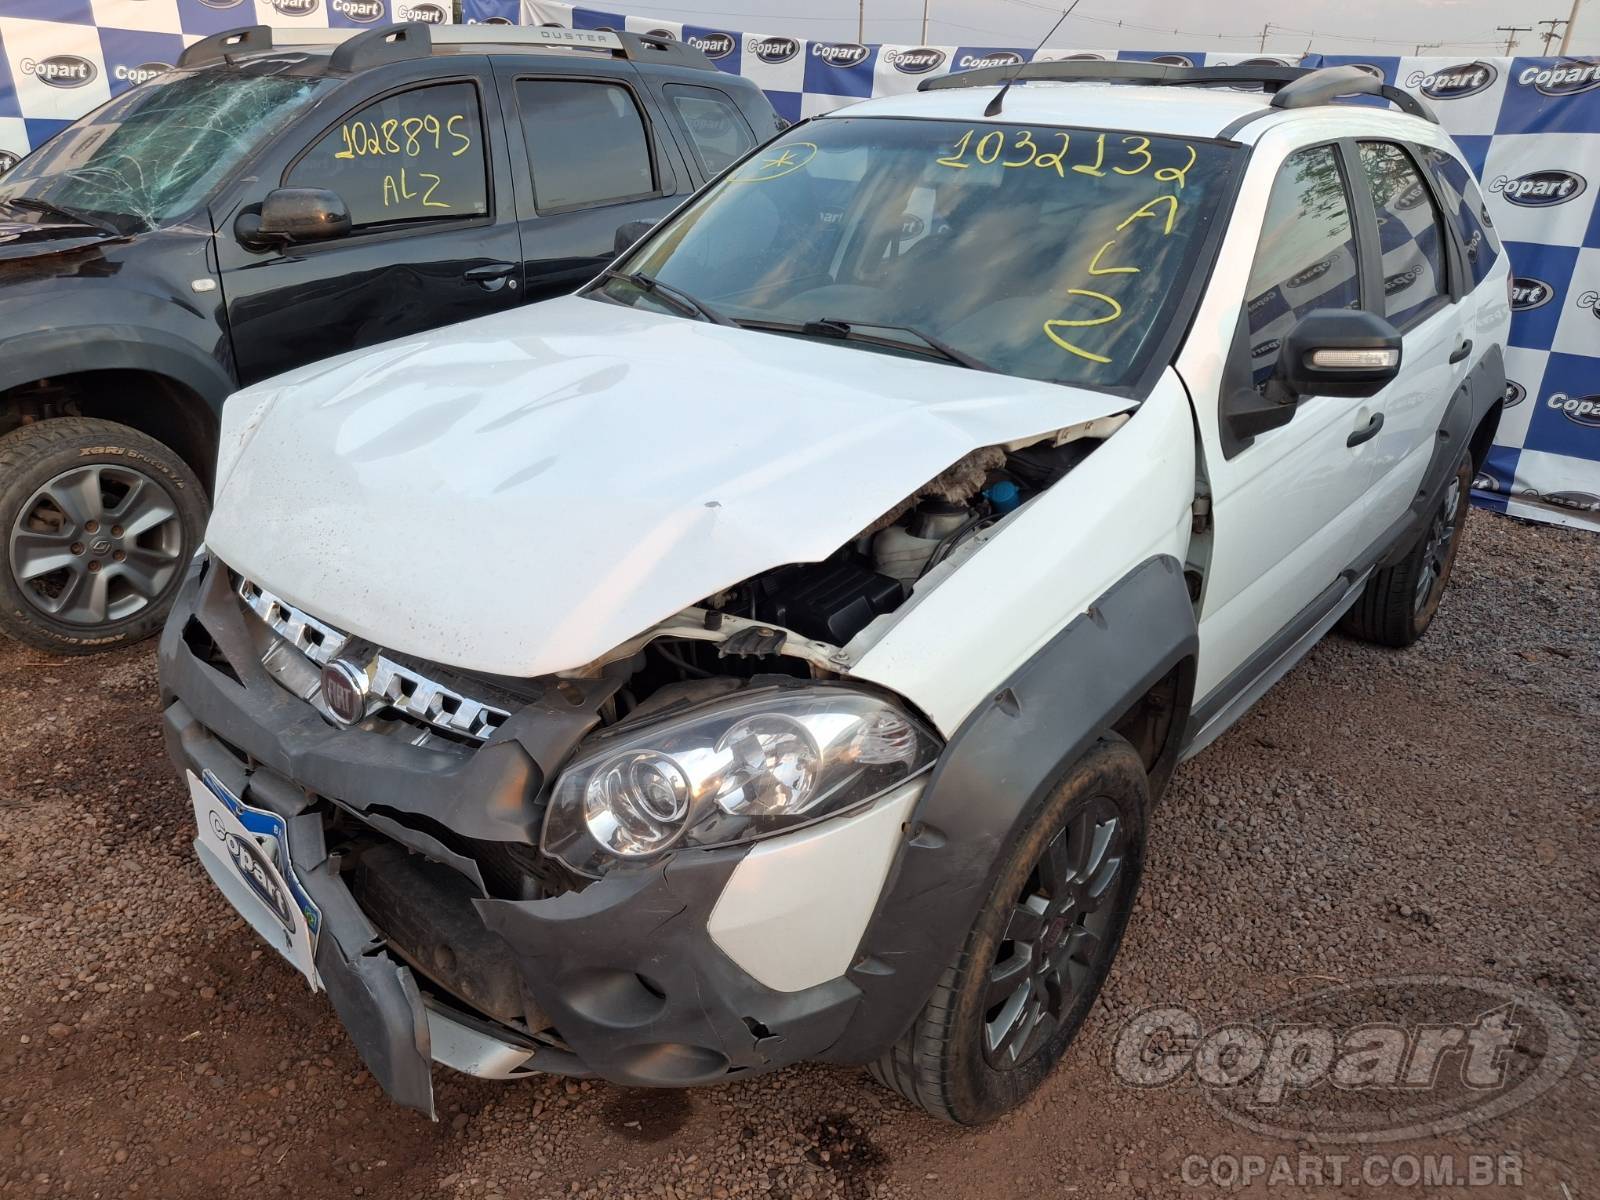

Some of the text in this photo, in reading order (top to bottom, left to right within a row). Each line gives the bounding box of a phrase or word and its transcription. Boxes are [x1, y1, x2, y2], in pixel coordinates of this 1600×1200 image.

[333, 0, 378, 17] Copart
[399, 5, 440, 22] Copart
[541, 31, 607, 42] DUSTER
[688, 37, 729, 52] Copart
[747, 39, 792, 55] Copart
[812, 43, 862, 61] Copart
[884, 50, 936, 66] Copart
[20, 57, 88, 79] Copart
[115, 65, 161, 84] Copa
[1405, 66, 1484, 92] Copart
[936, 128, 1197, 188] 1032132
[384, 168, 451, 207] ALZ
[1488, 175, 1571, 197] Copart
[1547, 392, 1600, 416] Copa
[208, 809, 287, 915] Copart
